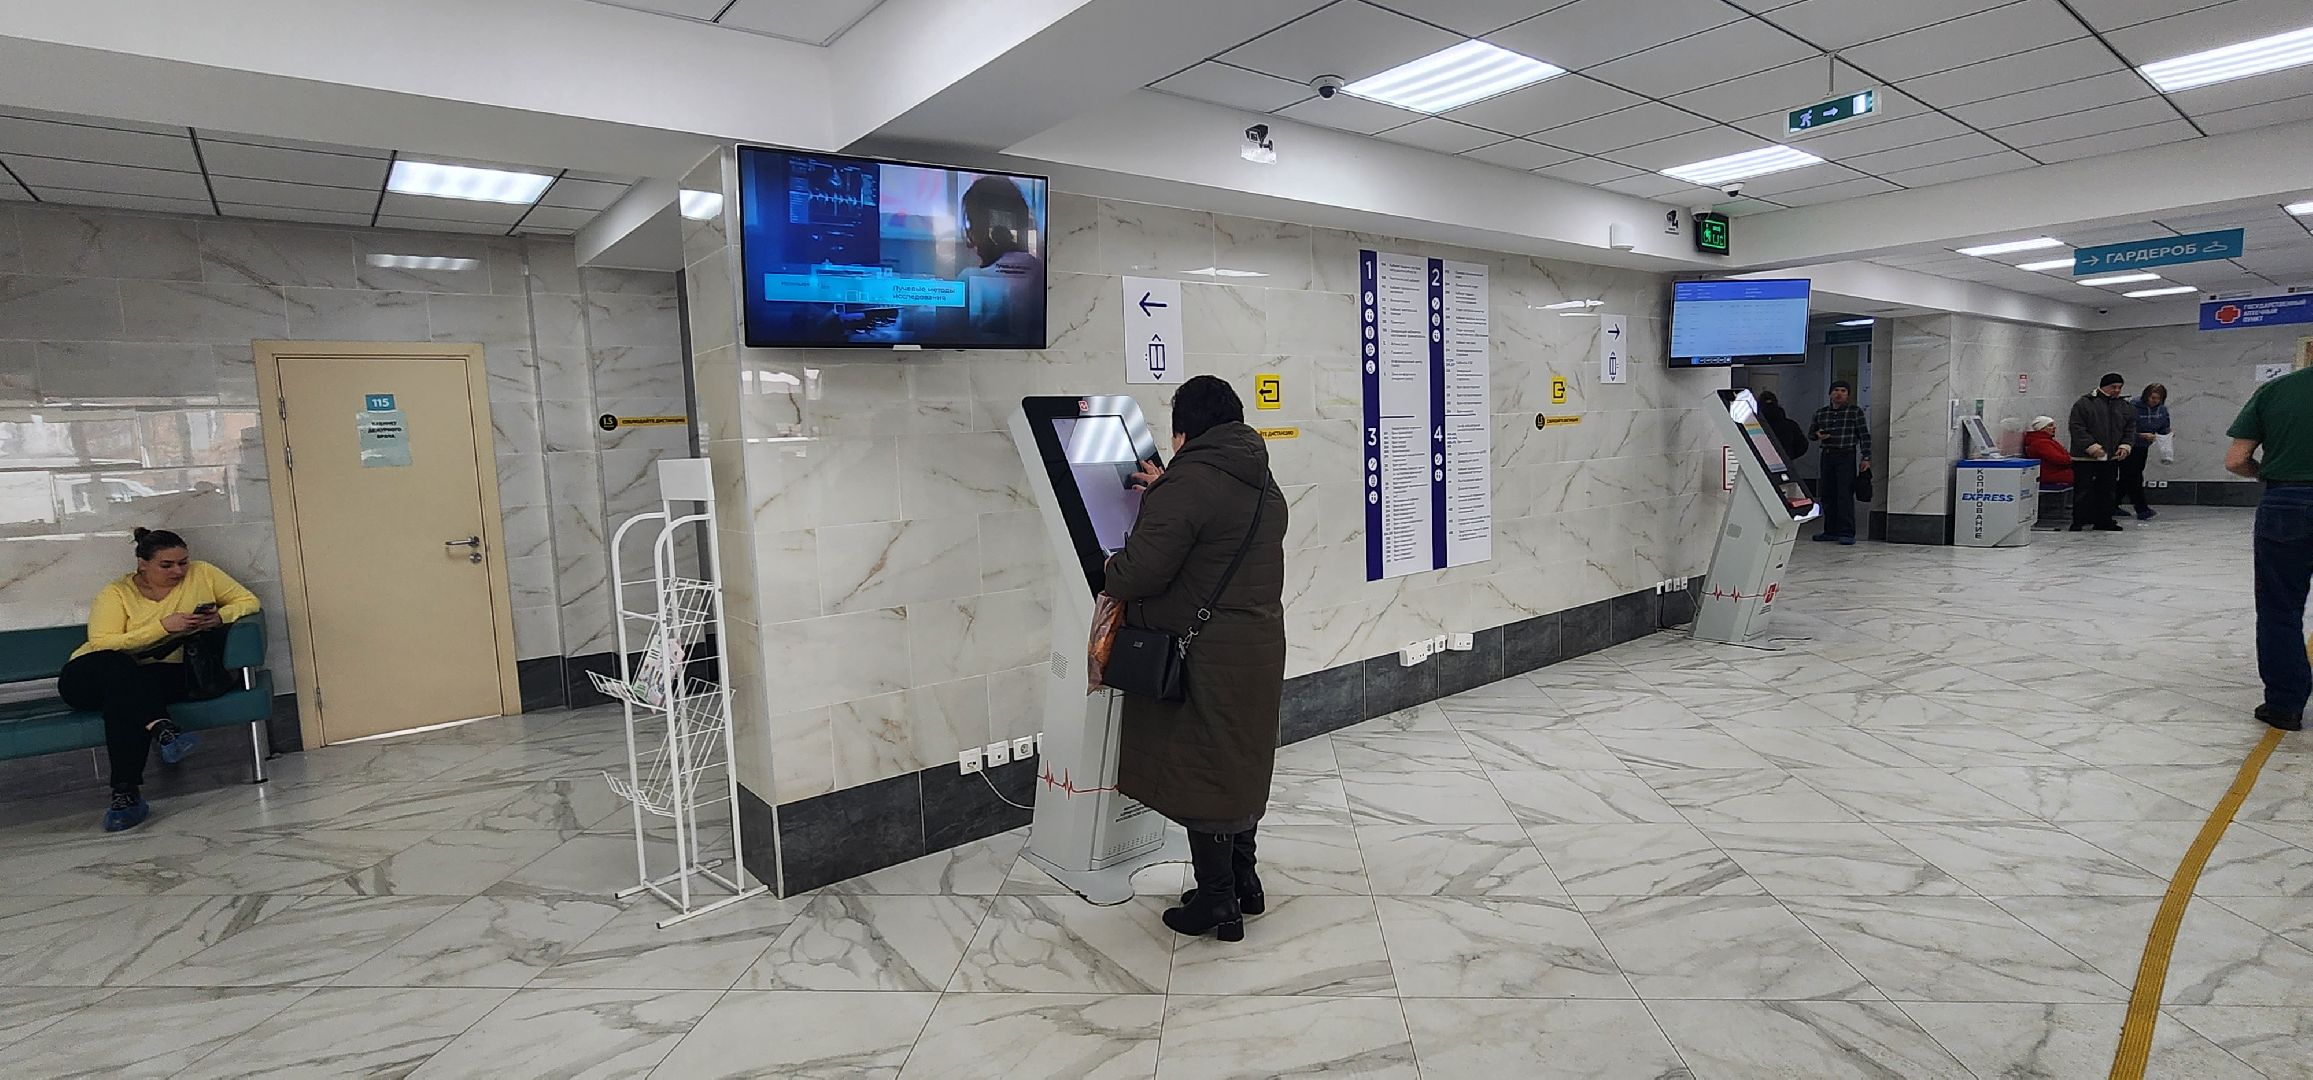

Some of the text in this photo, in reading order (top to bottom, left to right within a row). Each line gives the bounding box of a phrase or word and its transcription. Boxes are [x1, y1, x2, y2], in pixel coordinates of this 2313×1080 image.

[2106, 243, 2197, 264] ГАРДЕРОБ
[1365, 261, 1372, 280] 1
[1431, 268, 1441, 287] 2
[371, 398, 390, 408] 115
[1367, 427, 1378, 447] 3
[1433, 425, 1444, 443] 4
[1962, 493, 2015, 503] EXPRESS
[1975, 468, 1985, 539] КОПИРОВАНИЕ
